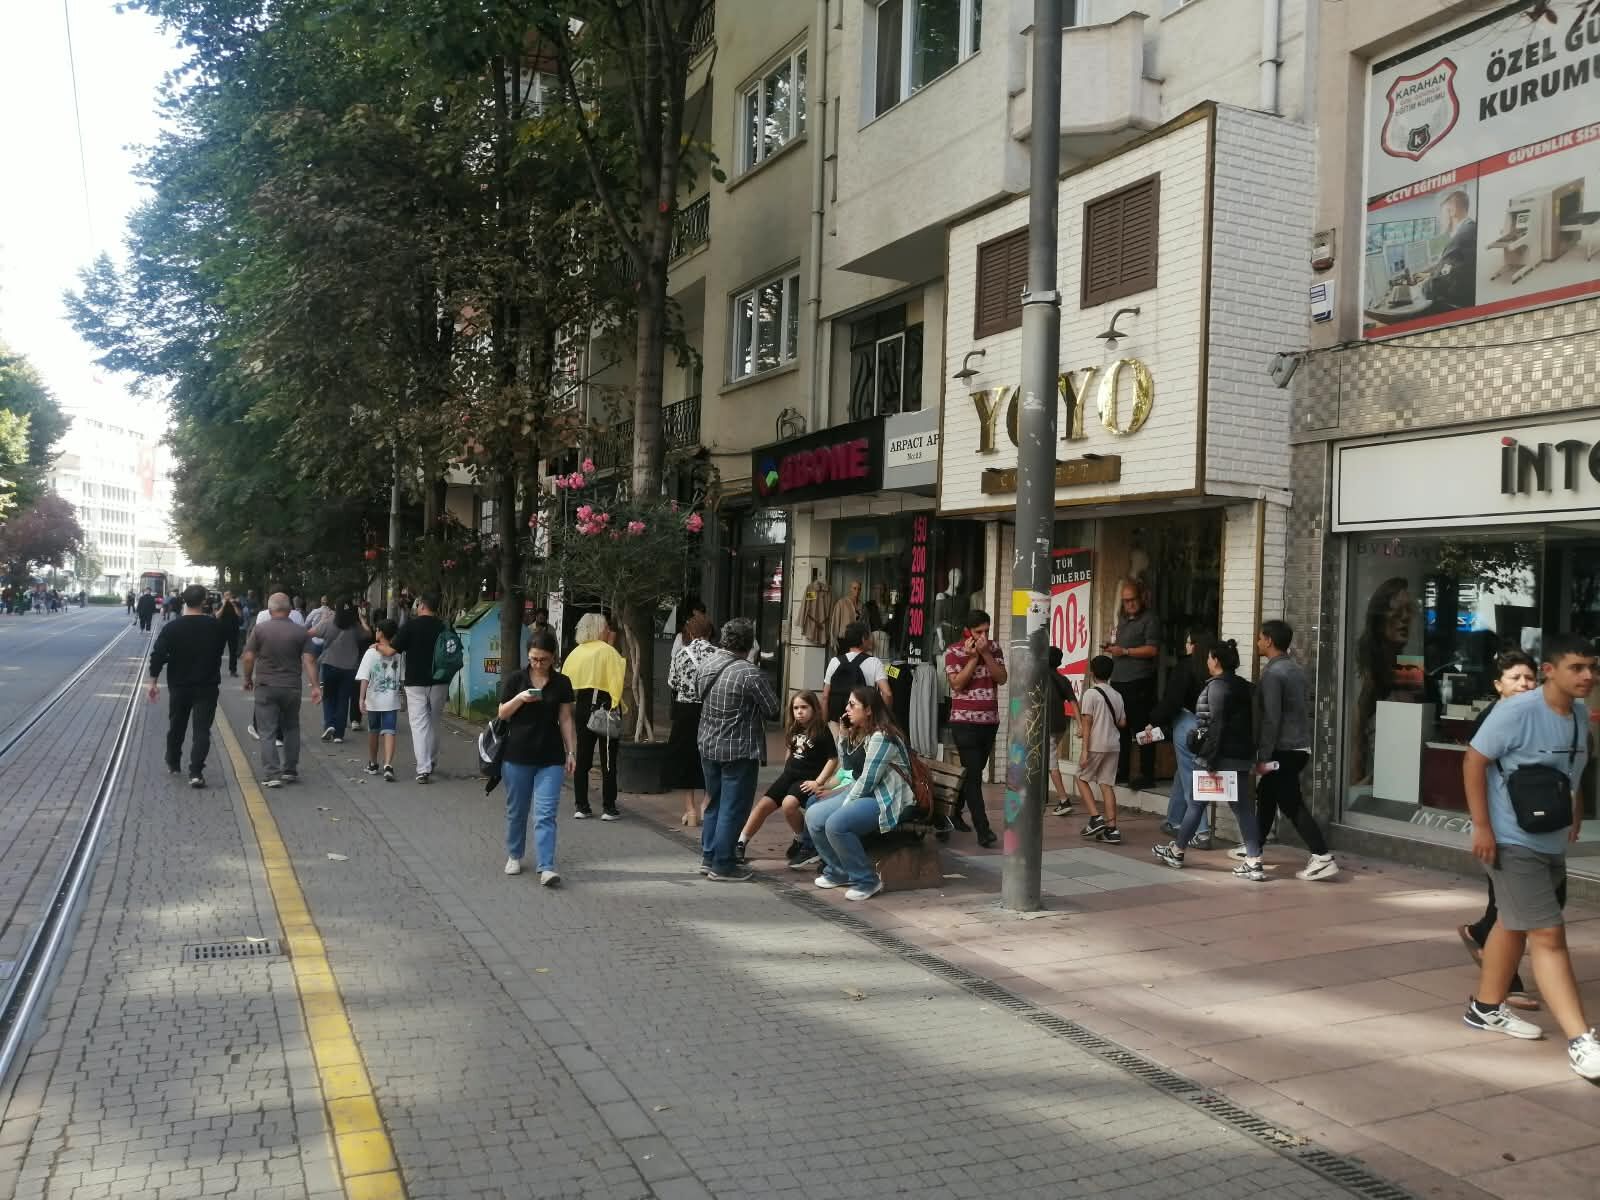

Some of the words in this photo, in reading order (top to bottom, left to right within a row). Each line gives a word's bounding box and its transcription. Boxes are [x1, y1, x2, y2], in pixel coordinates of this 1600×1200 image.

[1486, 37, 1557, 83] ÖZEL
[1395, 73, 1446, 101] KARAHAN
[1385, 186, 1413, 204] CCTV
[969, 357, 1155, 454] YYO
[889, 436, 923, 453] ARPACI
[913, 516, 928, 543] 150
[912, 545, 926, 573] 200
[910, 577, 925, 604] 250
[1051, 570, 1092, 585] ÜNLERDE
[909, 608, 923, 637] 300
